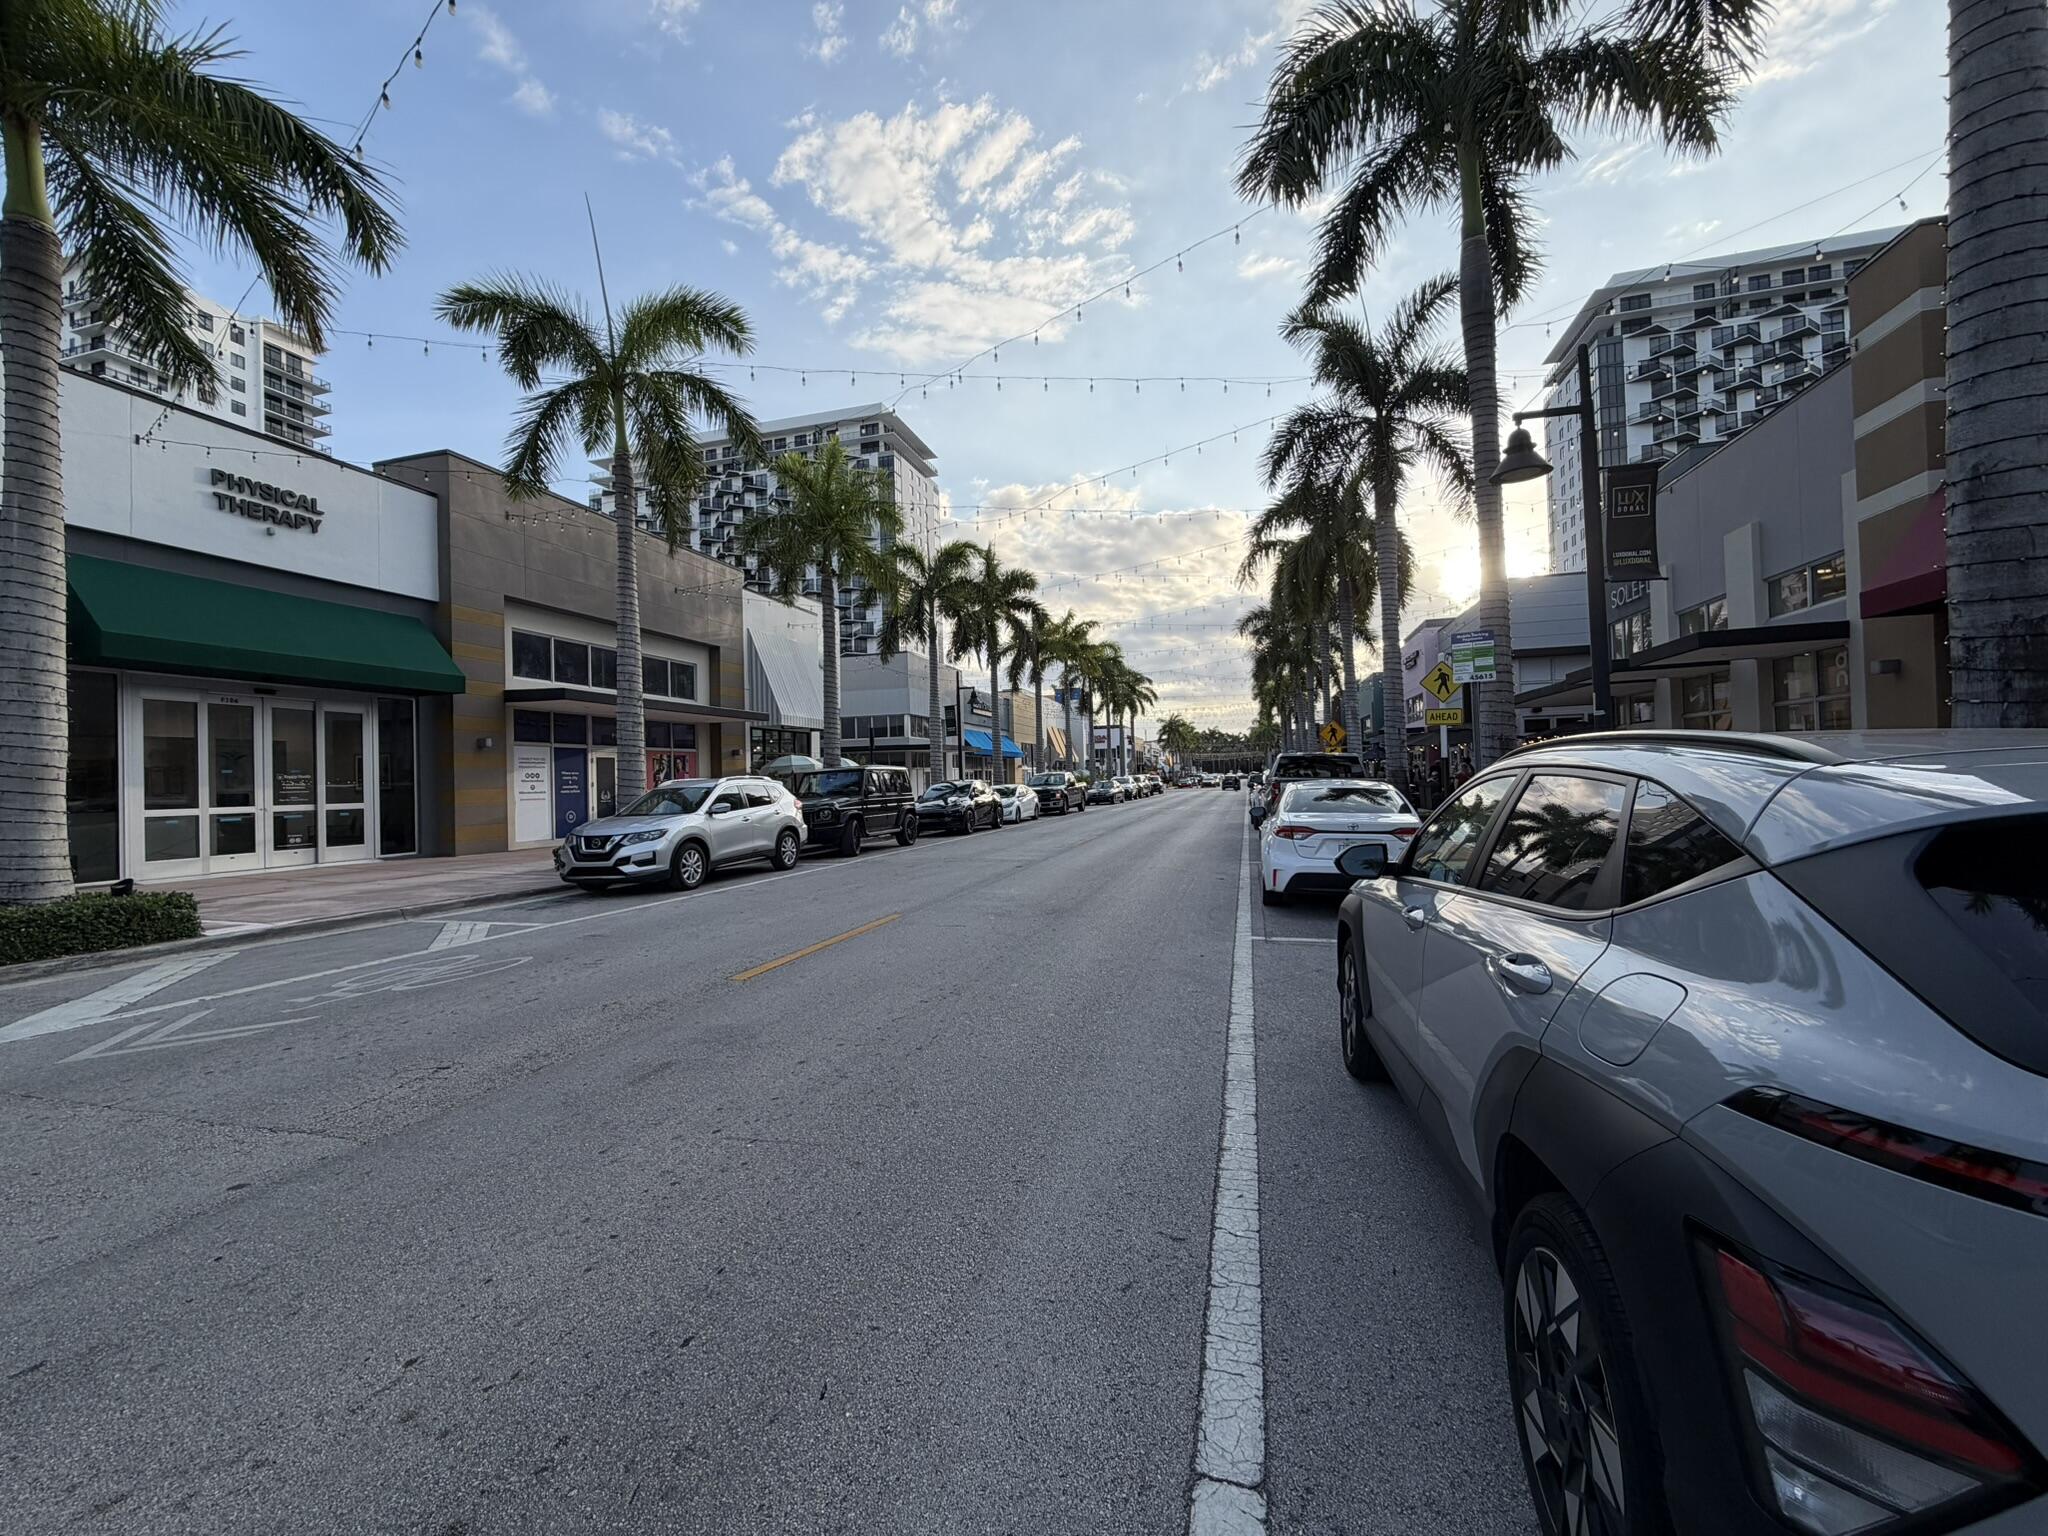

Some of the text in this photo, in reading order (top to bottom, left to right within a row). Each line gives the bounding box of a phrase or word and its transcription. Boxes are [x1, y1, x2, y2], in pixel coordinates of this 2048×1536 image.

[210, 468, 325, 516] PHYSICAL
[1617, 490, 1645, 505] LUX
[212, 491, 323, 534] THERAPY
[1617, 504, 1646, 513] DORAL
[1612, 550, 1652, 558] LUXDORAL.COM
[1429, 712, 1458, 721] AHEAD
